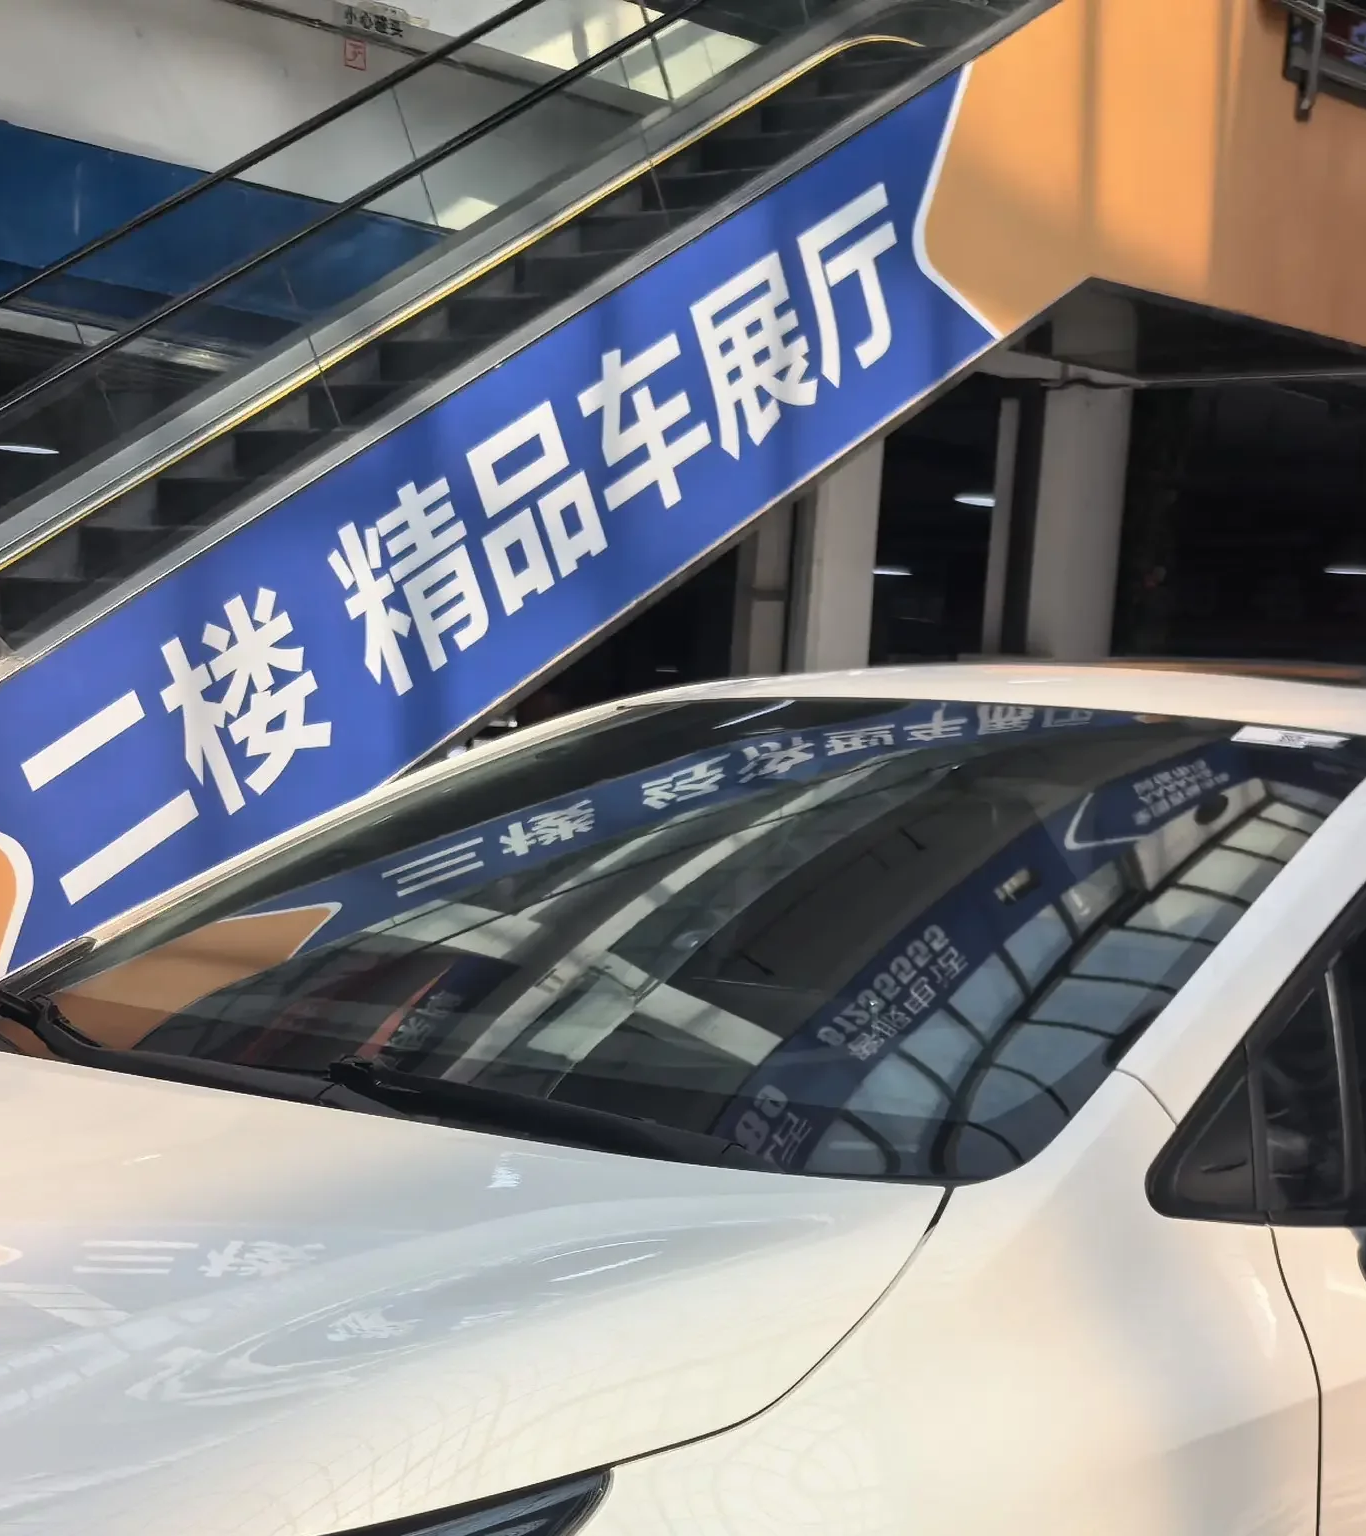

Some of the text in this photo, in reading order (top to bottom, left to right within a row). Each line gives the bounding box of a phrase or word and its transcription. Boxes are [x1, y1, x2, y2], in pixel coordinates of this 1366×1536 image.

[21, 182, 898, 905] 二楼 精品车展厅
